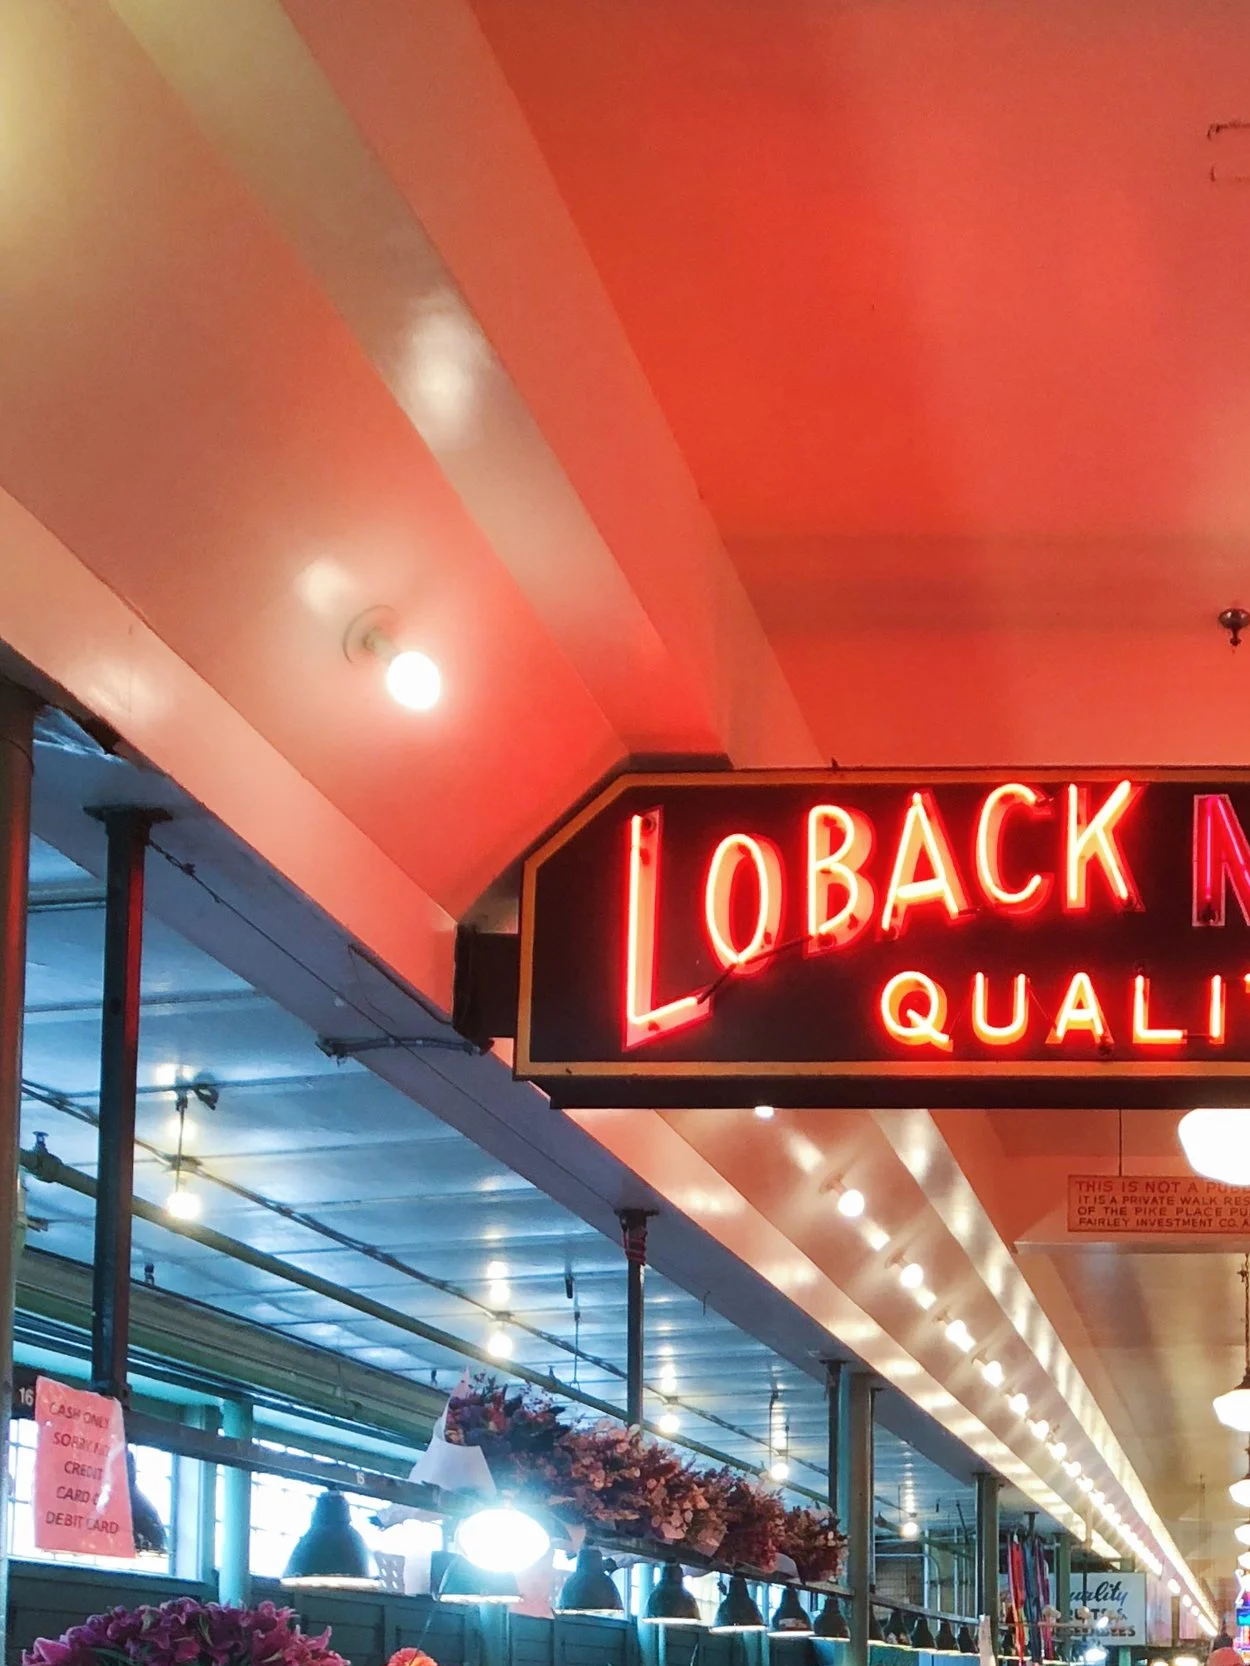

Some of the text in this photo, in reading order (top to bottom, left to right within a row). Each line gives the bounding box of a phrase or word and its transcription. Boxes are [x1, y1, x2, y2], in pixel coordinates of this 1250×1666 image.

[621, 779, 1145, 1052] LOBACK
[1075, 1181, 1113, 1192] THIS
[1121, 1181, 1139, 1193] IS
[1145, 1182, 1181, 1193] NOT
[1188, 1182, 1198, 1193] A
[1078, 1196, 1090, 1204] IT
[1094, 1196, 1105, 1204] IS
[1107, 1196, 1117, 1204] A
[1122, 1196, 1176, 1205] PRIVATE
[1179, 1196, 1217, 1205] WALK
[1077, 1207, 1096, 1216] OF
[1103, 1207, 1127, 1216] THE
[1135, 1207, 1168, 1216] PIKE
[1176, 1207, 1222, 1217] PLACE
[1079, 1218, 1129, 1227] FAIRLEY
[1136, 1218, 1213, 1228] INVESTMENT
[18, 1387, 34, 1406] 16
[50, 1402, 109, 1429] CASH ONLY
[56, 1486, 90, 1503] CARD
[45, 1511, 119, 1535] DEBIT CARD
[1070, 1581, 1128, 1606] uality
